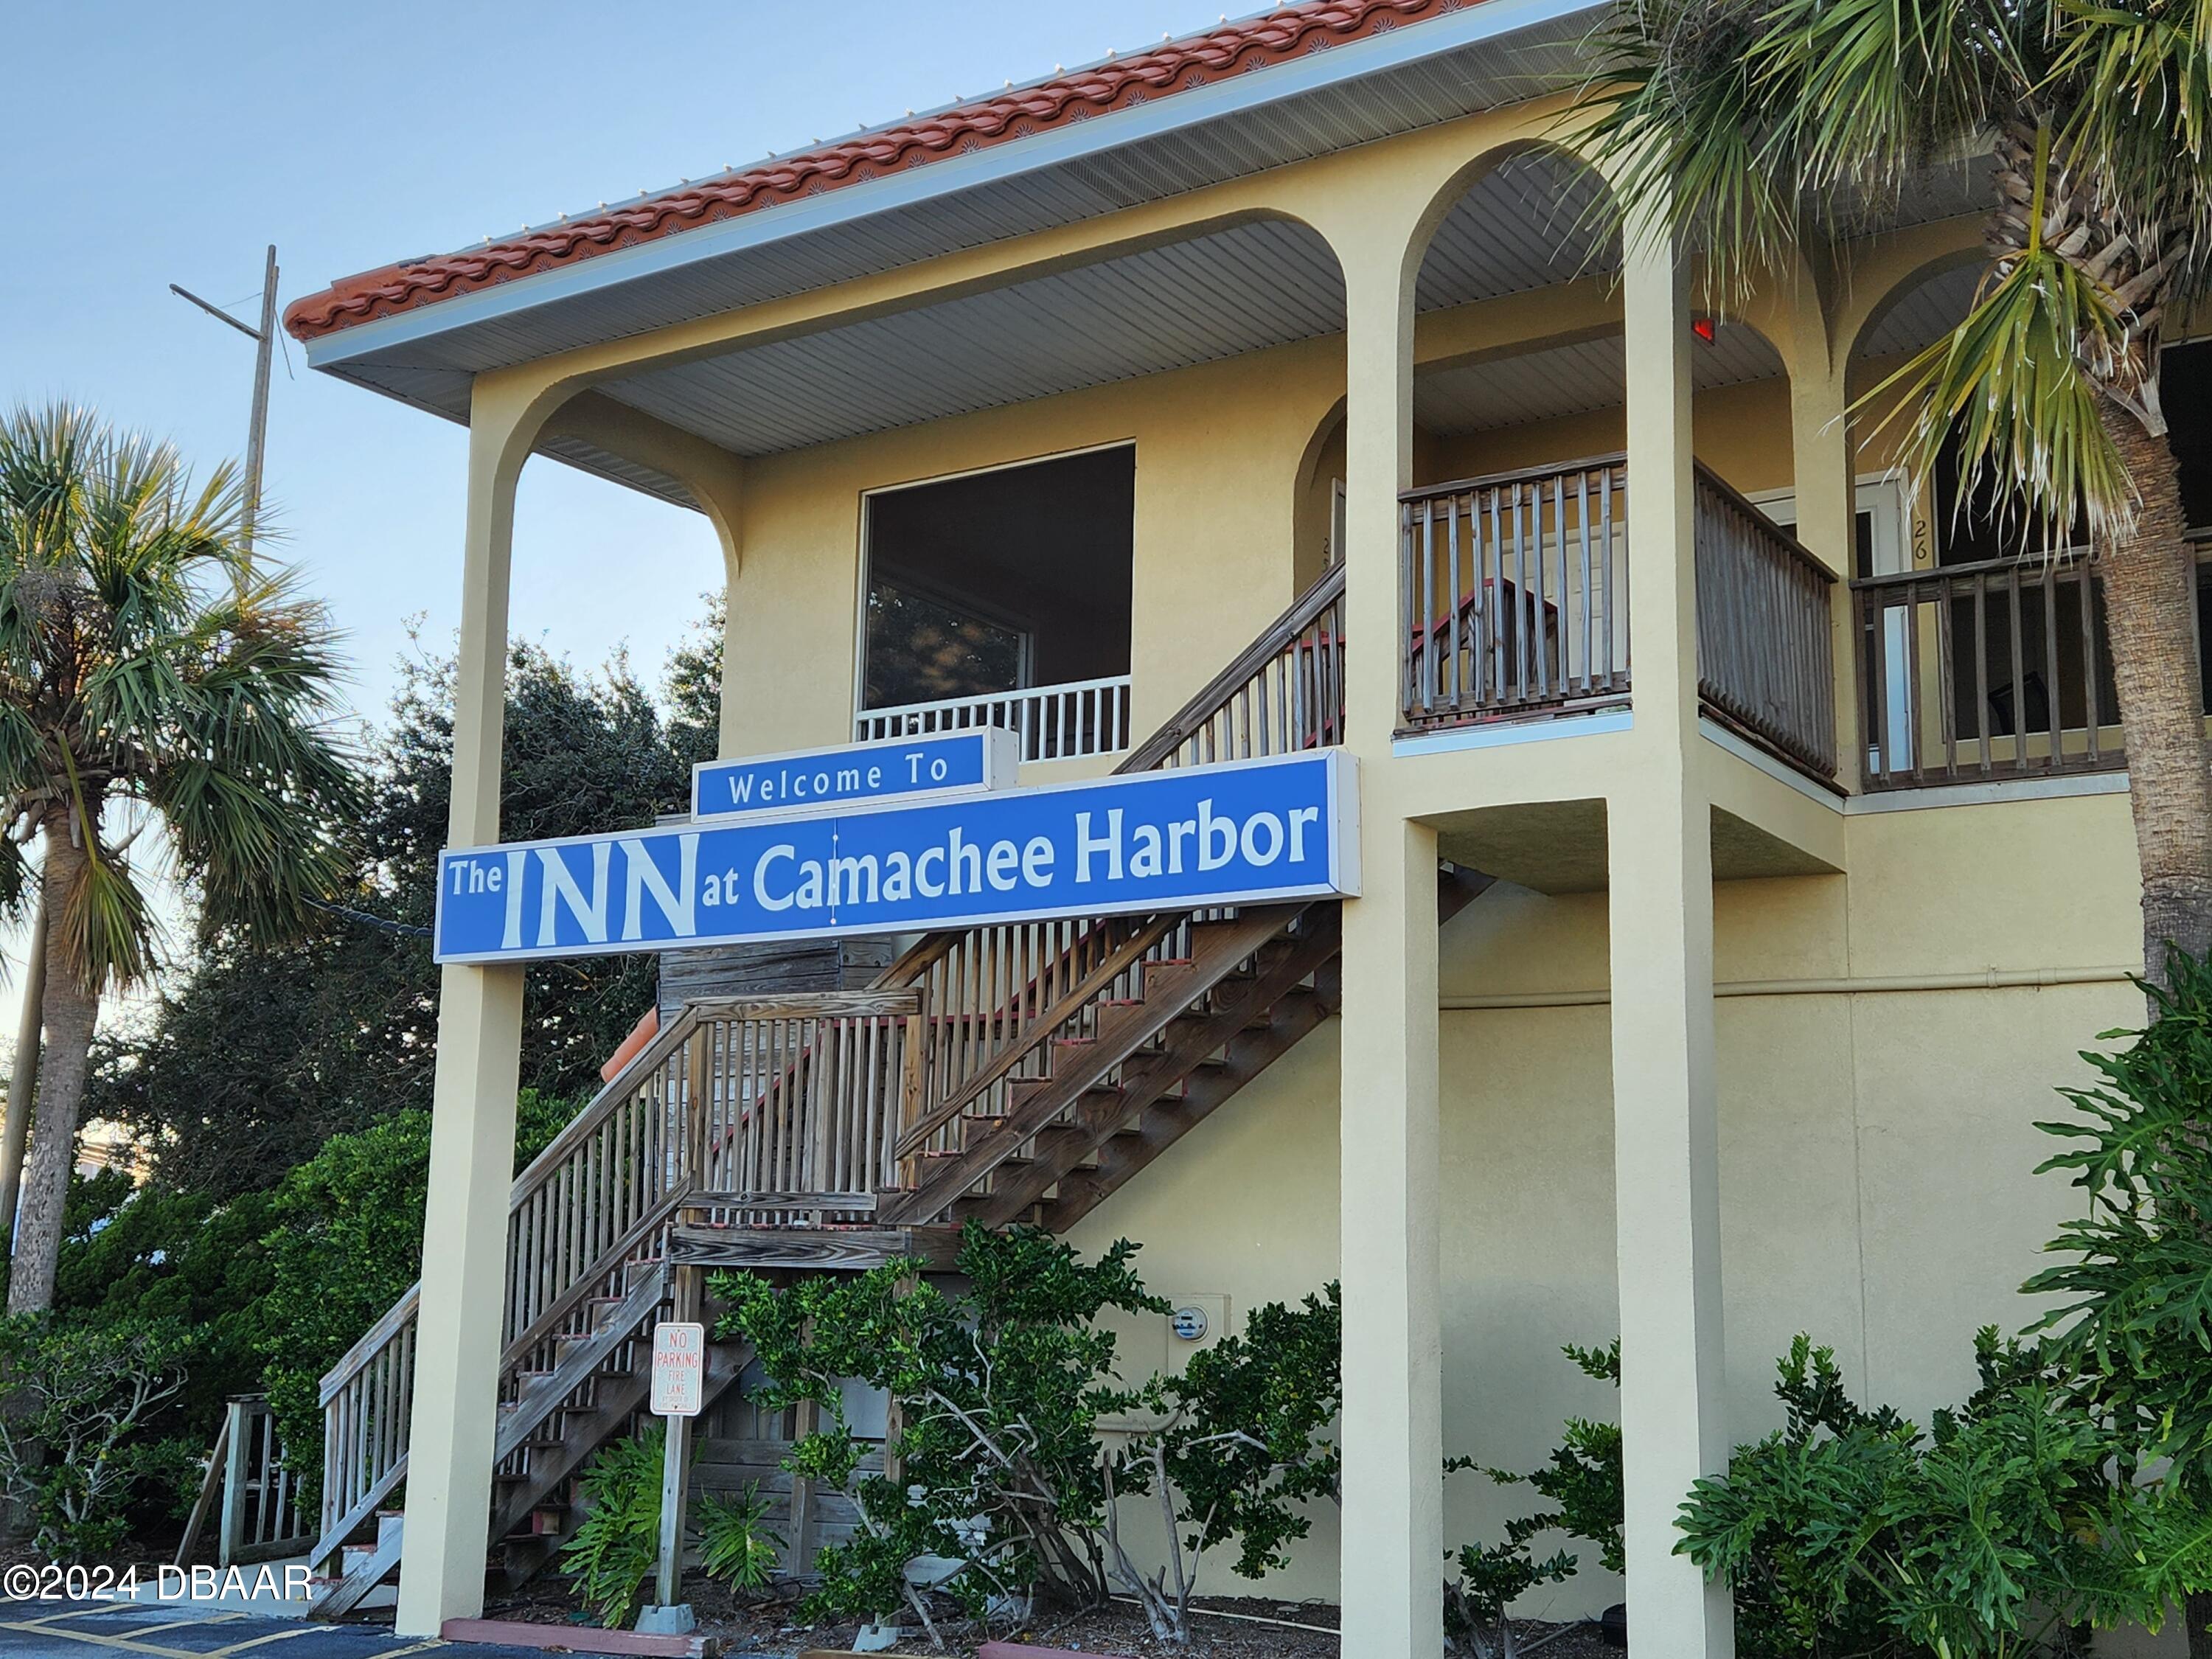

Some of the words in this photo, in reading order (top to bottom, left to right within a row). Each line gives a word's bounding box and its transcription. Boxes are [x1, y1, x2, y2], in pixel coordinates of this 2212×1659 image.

[1915, 520, 1927, 560] 26
[728, 765, 882, 804] Welcome
[904, 752, 947, 784] To
[448, 860, 502, 895] The
[501, 832, 700, 949] INN
[702, 867, 739, 906] at
[753, 826, 1055, 911] Camachee
[1074, 798, 1318, 883] Harbor
[669, 1332, 687, 1349] NO
[656, 1352, 698, 1368] PARKING
[668, 1370, 685, 1382] FIRE
[667, 1383, 685, 1395] LANE
